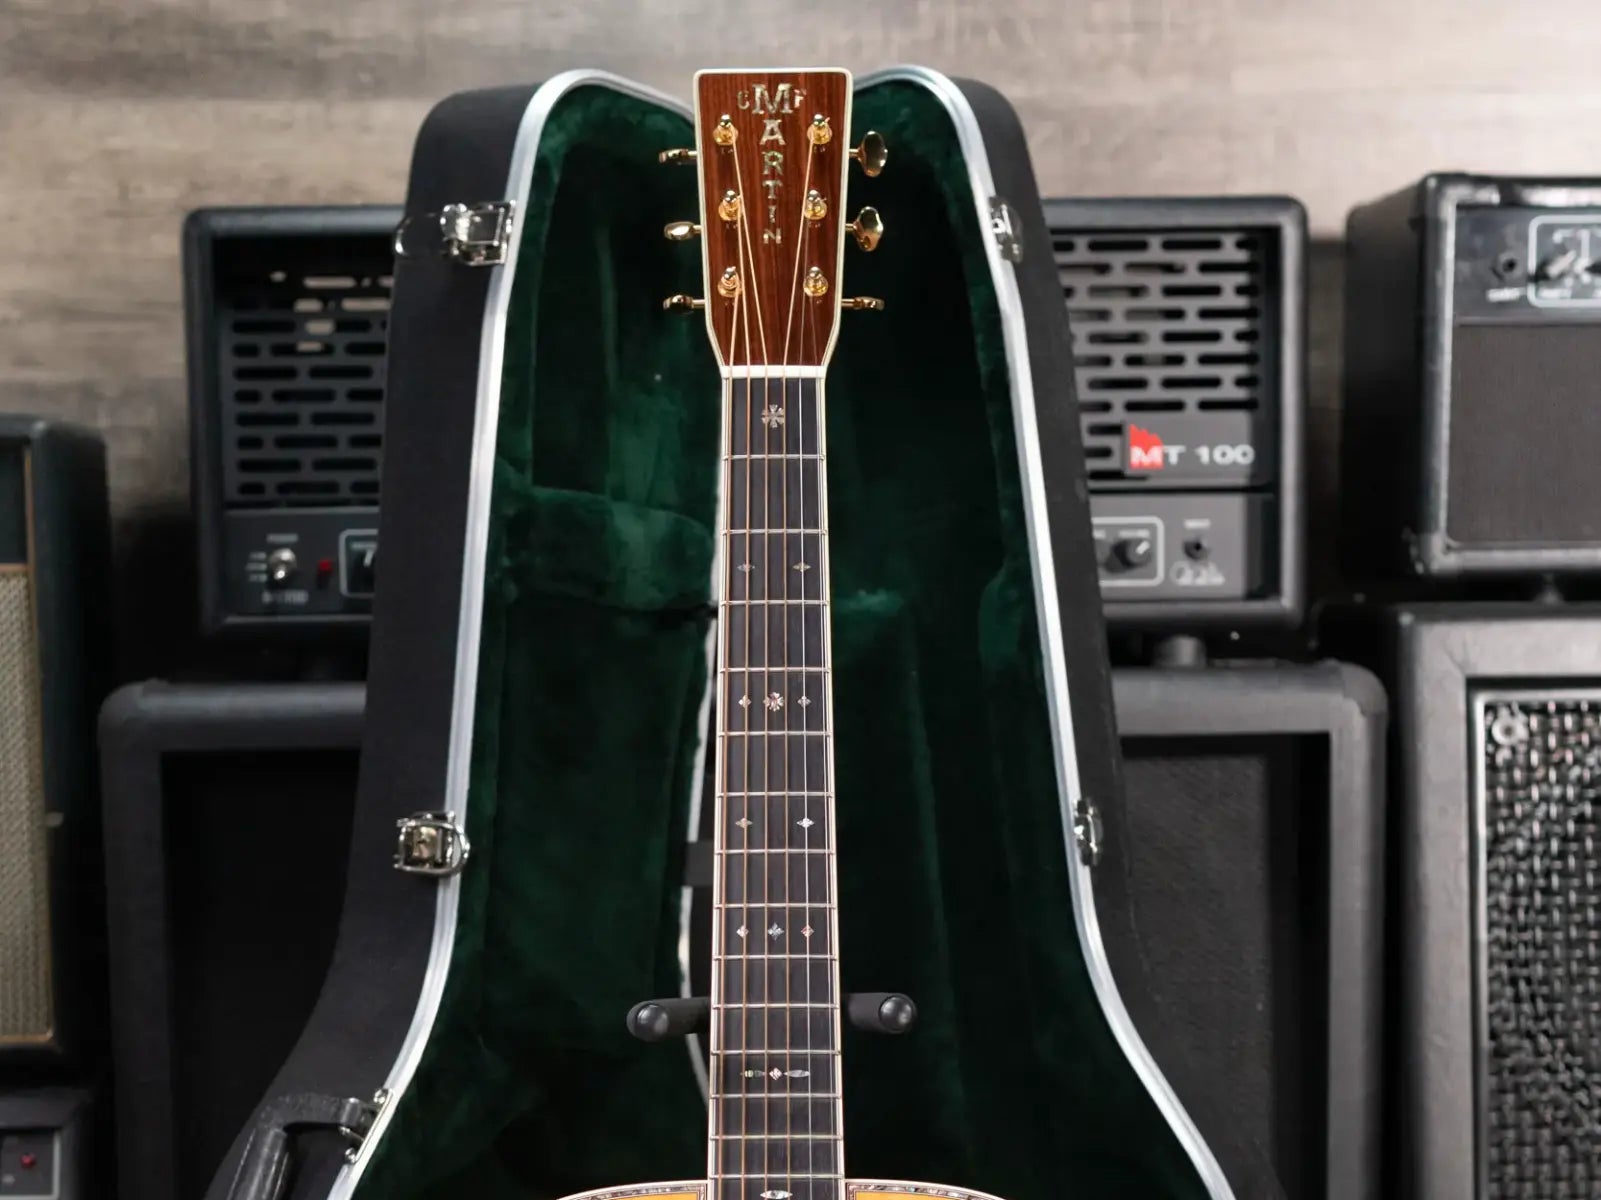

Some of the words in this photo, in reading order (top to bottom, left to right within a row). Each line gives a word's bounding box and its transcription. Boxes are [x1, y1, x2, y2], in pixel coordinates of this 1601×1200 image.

[751, 82, 794, 244] MARTIN
[1129, 444, 1186, 468] MT
[1195, 444, 1255, 465] 100
